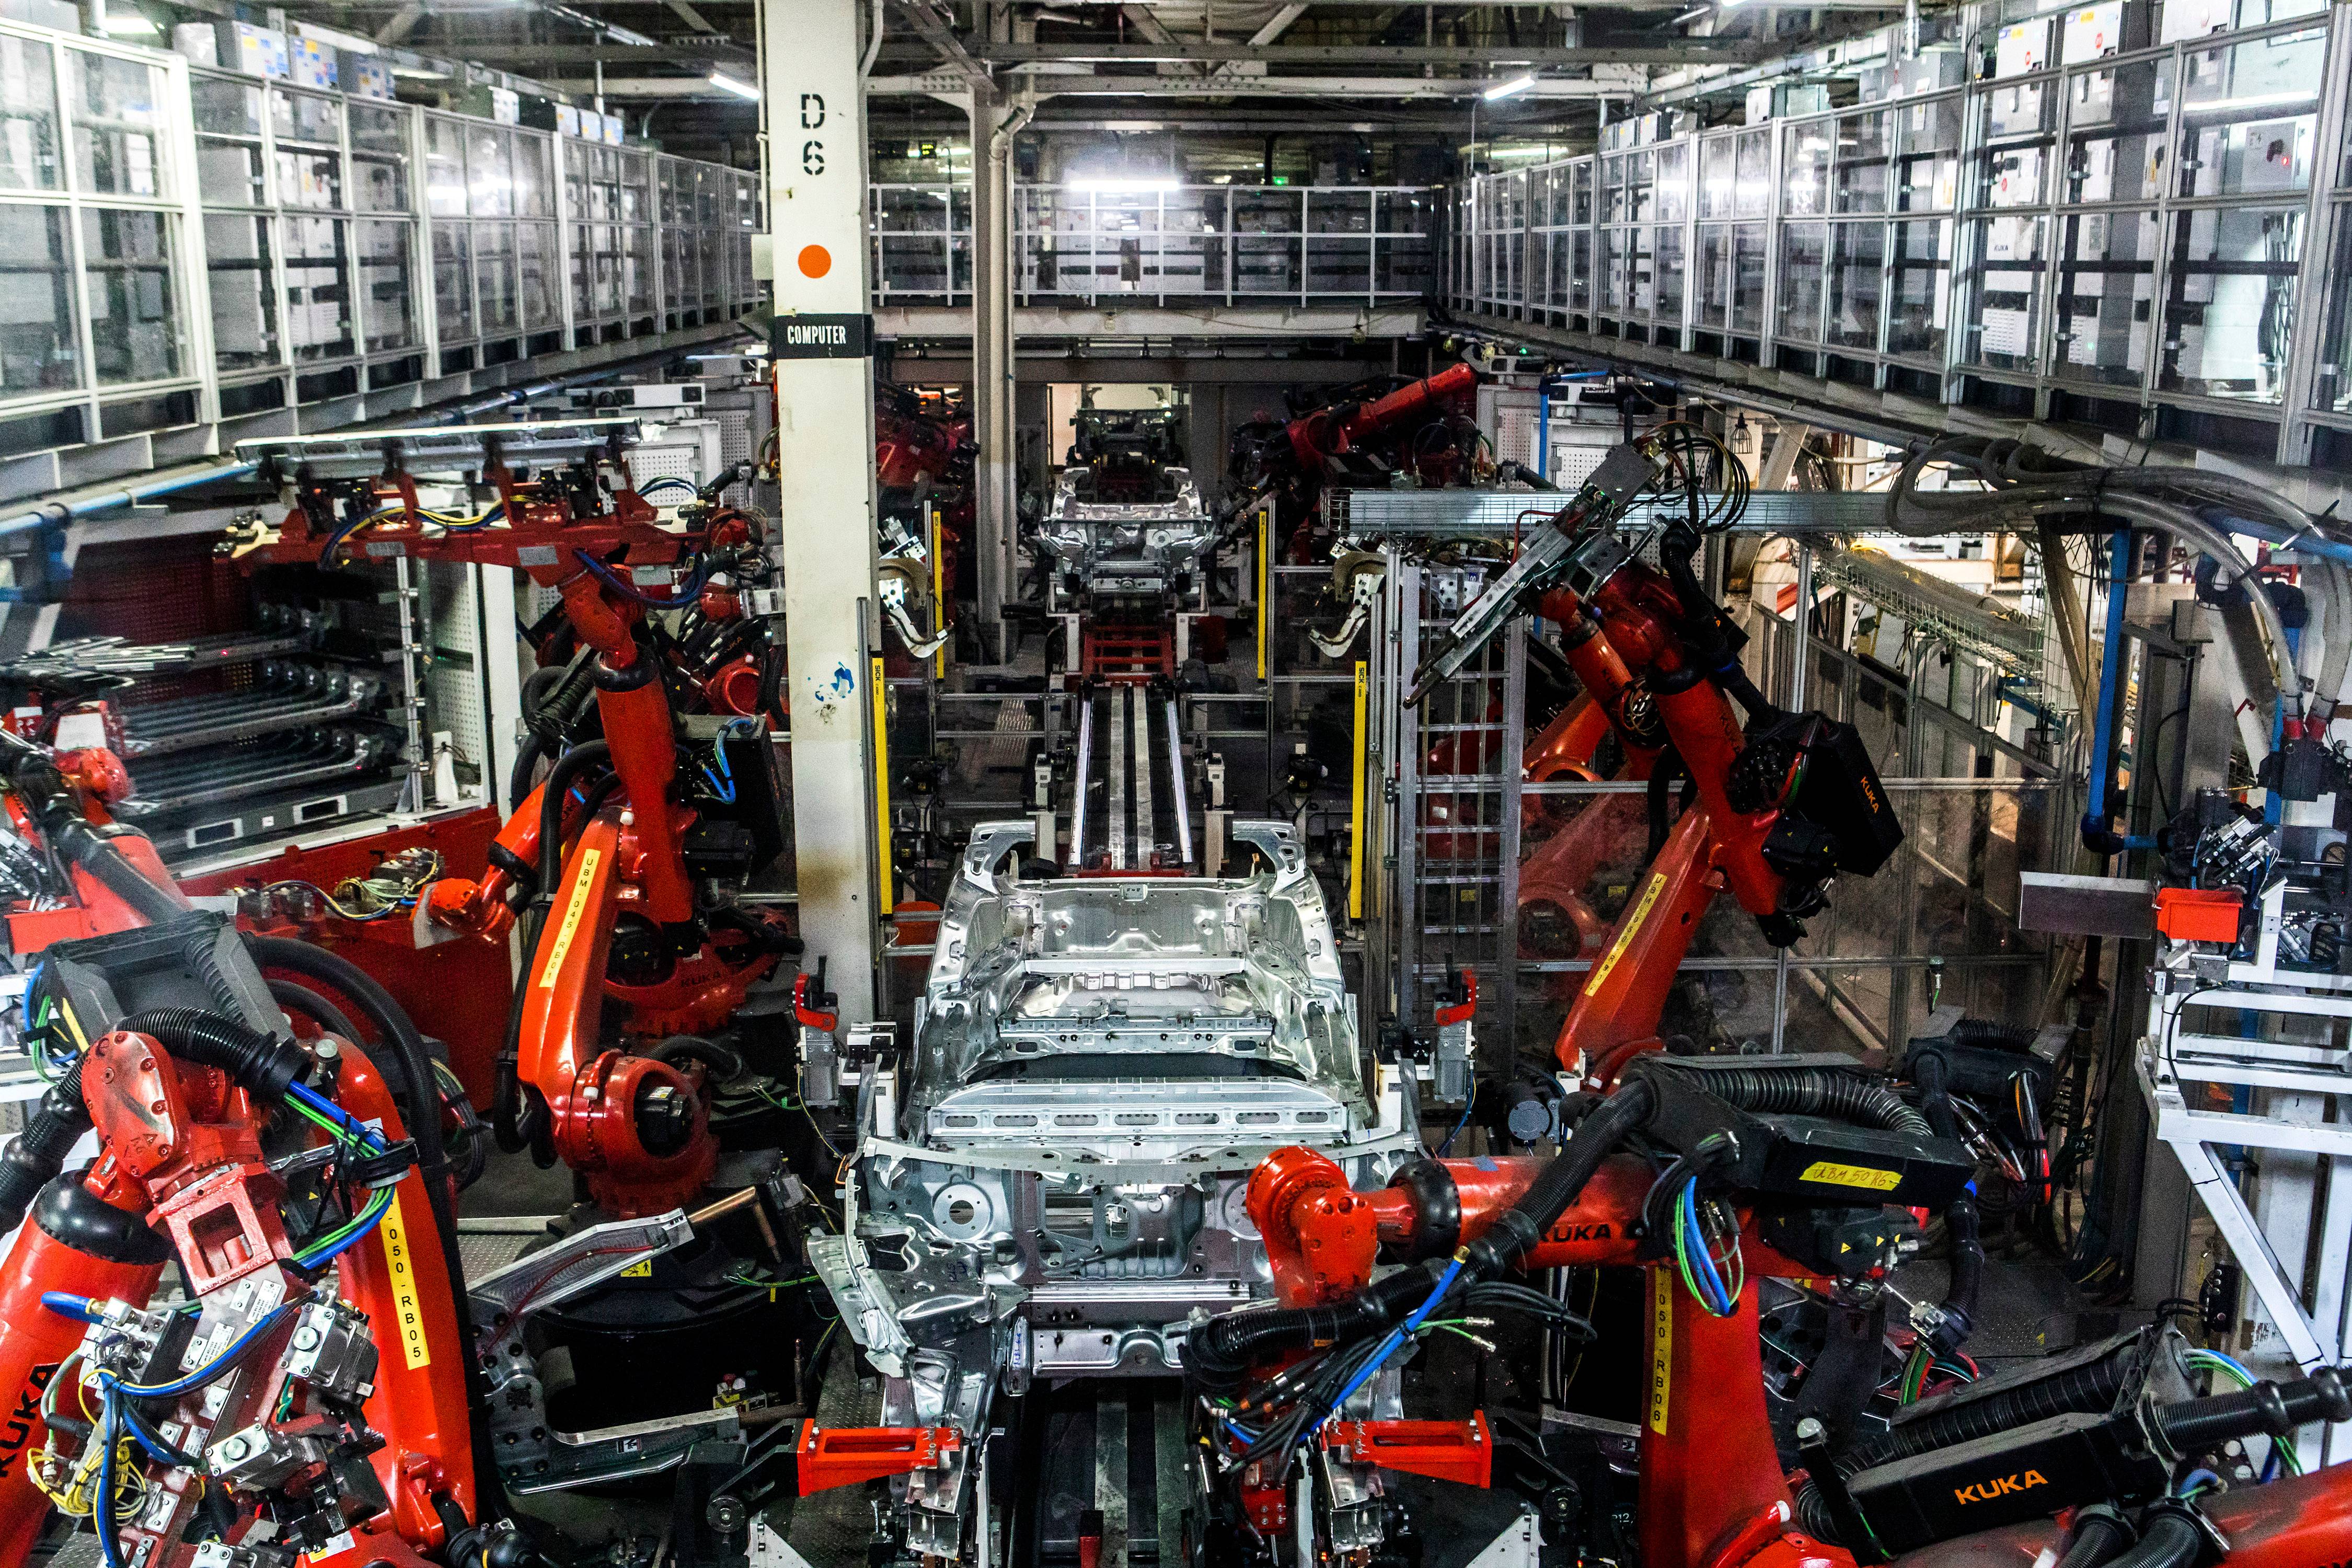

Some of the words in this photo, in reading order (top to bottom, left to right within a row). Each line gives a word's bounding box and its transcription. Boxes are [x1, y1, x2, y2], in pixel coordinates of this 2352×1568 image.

[787, 325, 846, 344] COMPUTER
[1861, 776, 1879, 814] KUKA
[1814, 1166, 1848, 1181] UBM
[1848, 1170, 1869, 1183] 50
[1954, 1469, 2048, 1505] KUKA
